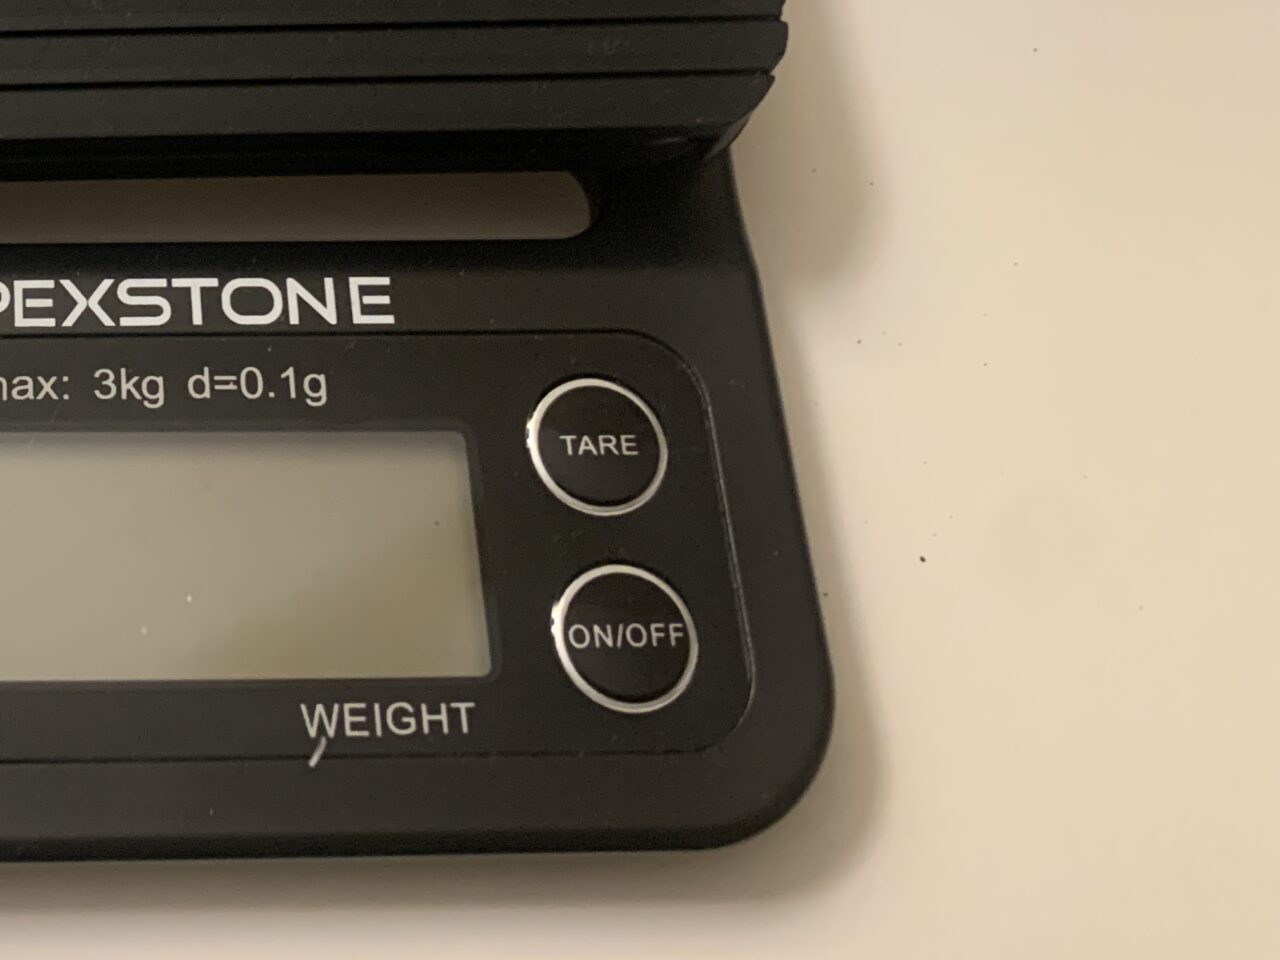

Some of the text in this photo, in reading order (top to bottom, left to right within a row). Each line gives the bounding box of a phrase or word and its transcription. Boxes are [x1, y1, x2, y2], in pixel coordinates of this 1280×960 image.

[93, 367, 165, 409] 3kg
[187, 366, 328, 408] d=0.1g
[559, 434, 639, 457] TARE
[568, 623, 684, 649] ON/OFF
[300, 702, 476, 739] WEIGHT
